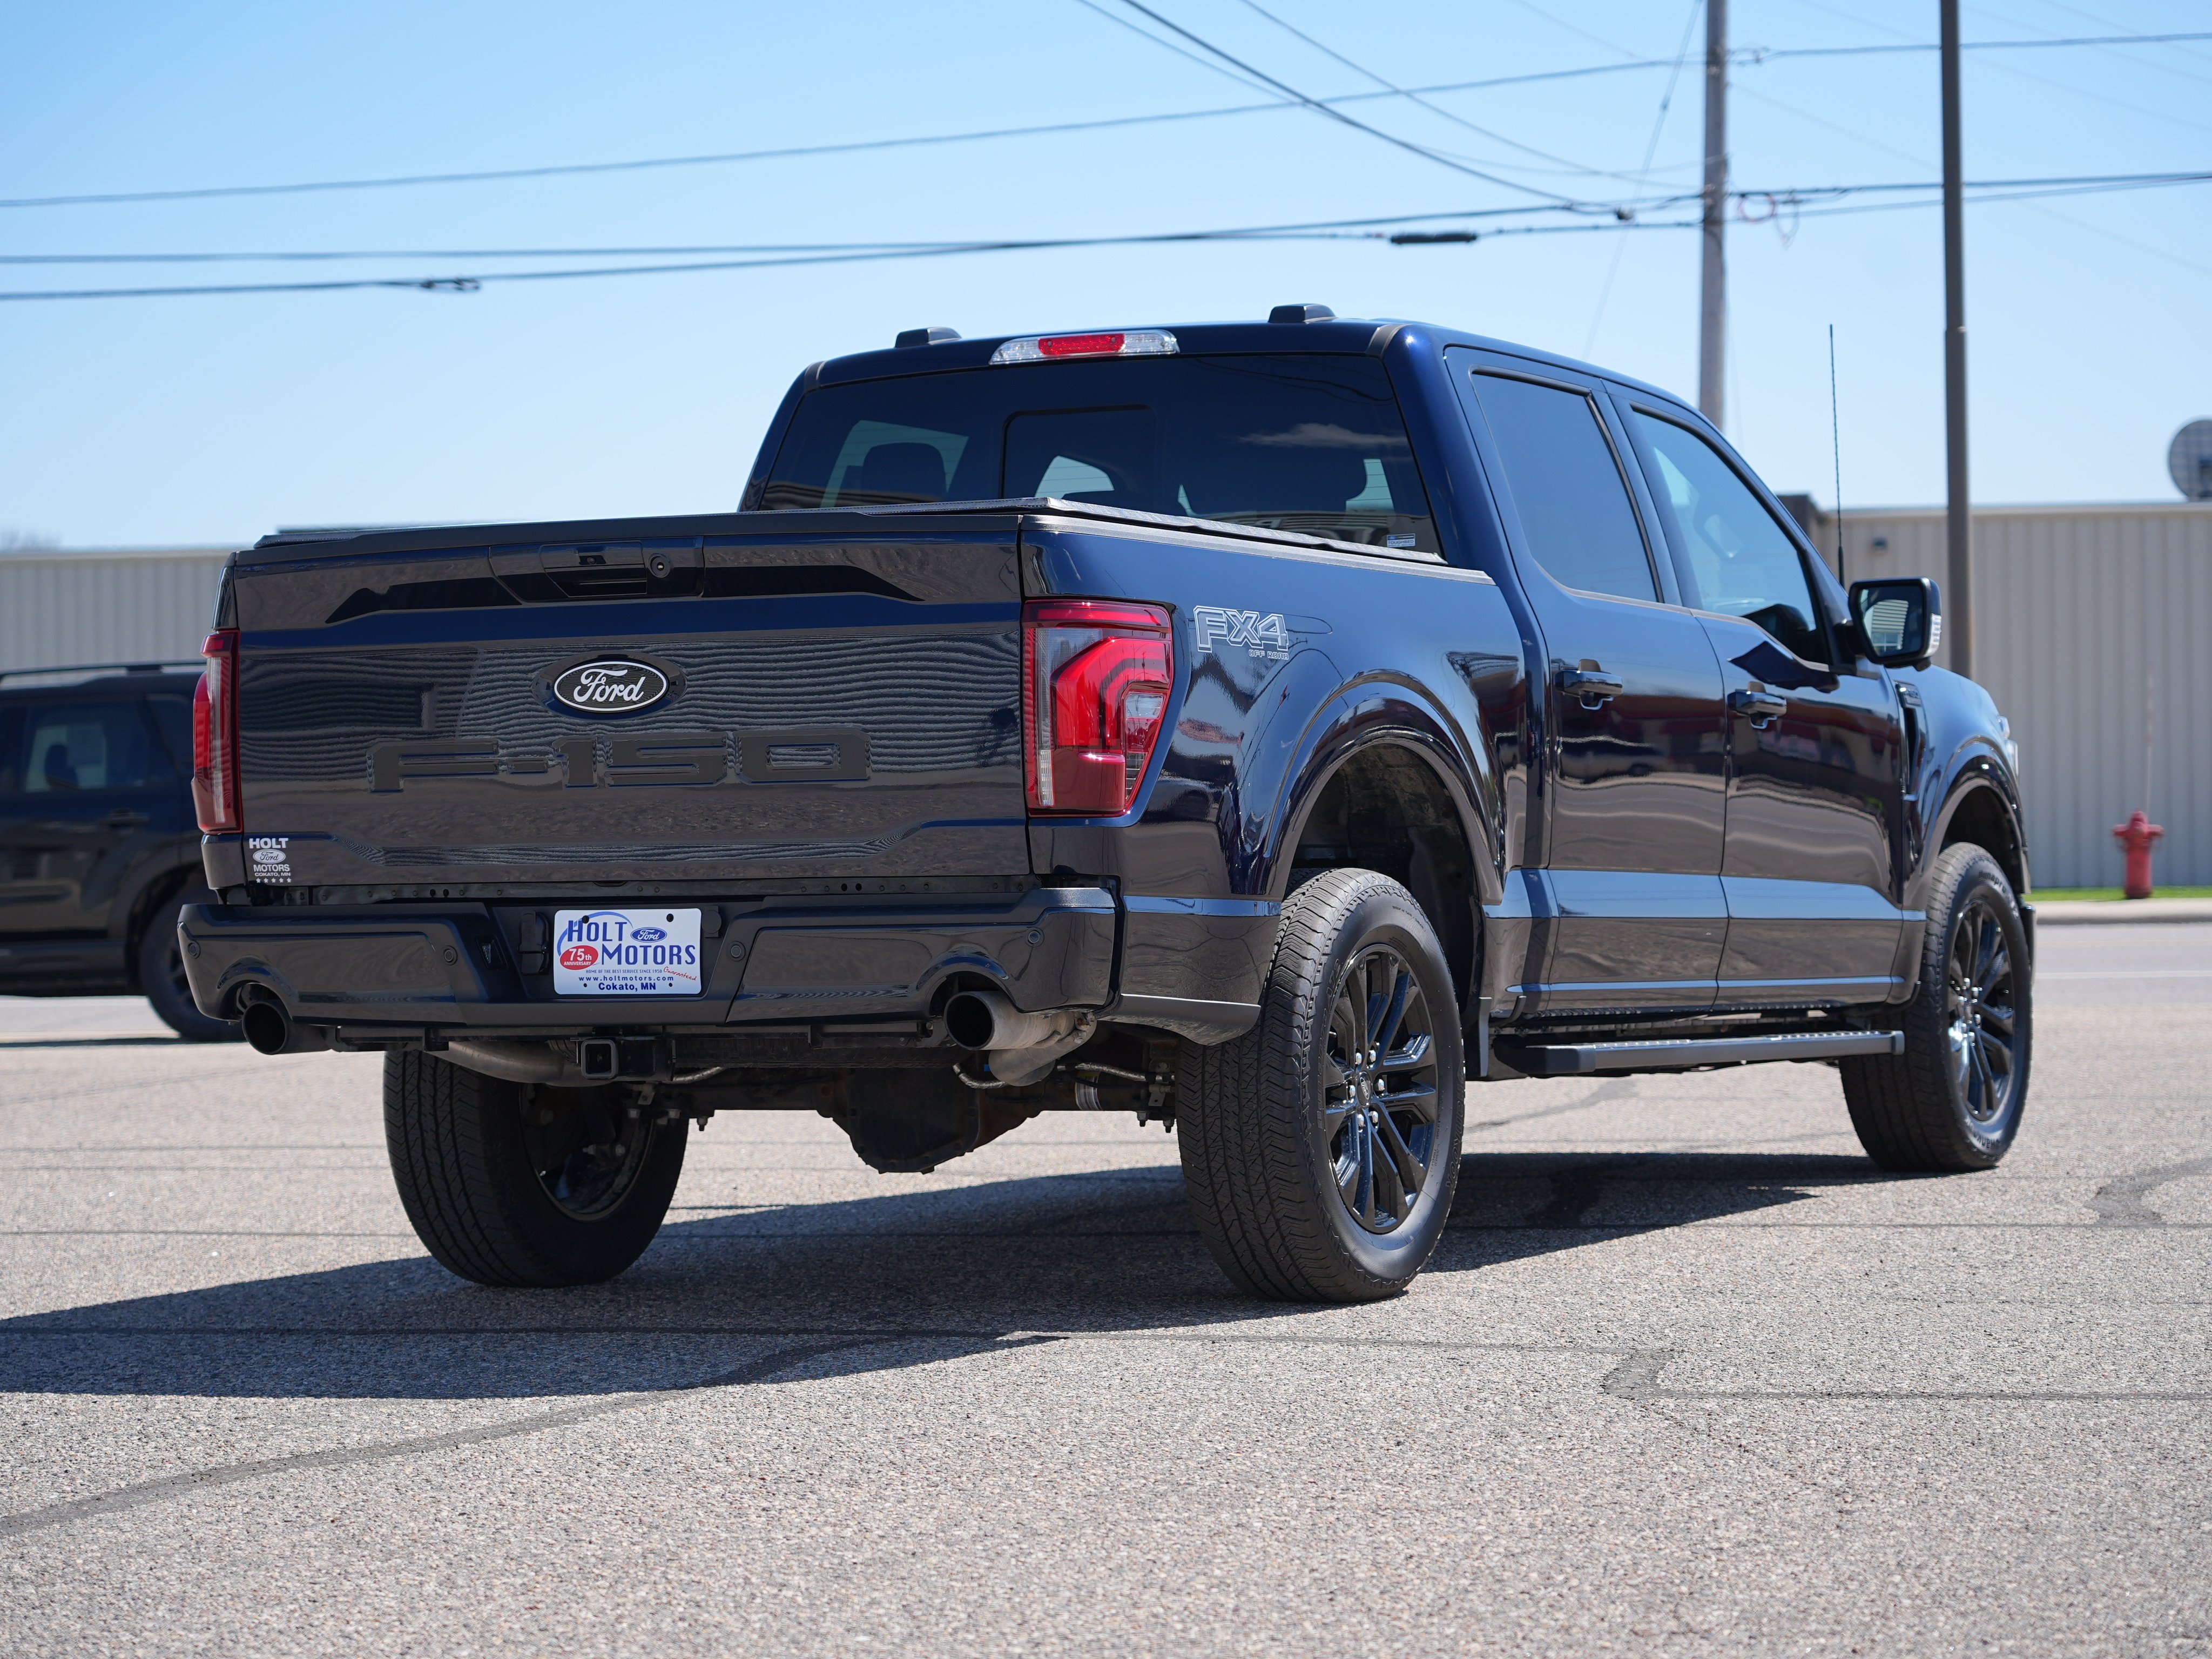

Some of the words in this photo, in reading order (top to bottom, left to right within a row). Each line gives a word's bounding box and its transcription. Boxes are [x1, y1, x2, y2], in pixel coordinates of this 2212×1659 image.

[1193, 605, 1289, 652] FX4
[1267, 651, 1289, 660] ROAD
[574, 669, 646, 702] Ford
[367, 729, 871, 793] F-150
[249, 838, 288, 849] HOLT
[260, 852, 279, 861] Ford
[568, 920, 627, 941] HOLT
[638, 929, 660, 940] Ford
[569, 948, 592, 961] 75th
[602, 943, 696, 965] MOTORS
[663, 966, 697, 981] Guaranteed
[598, 982, 638, 992] Cokato,
[640, 982, 656, 990] MN
